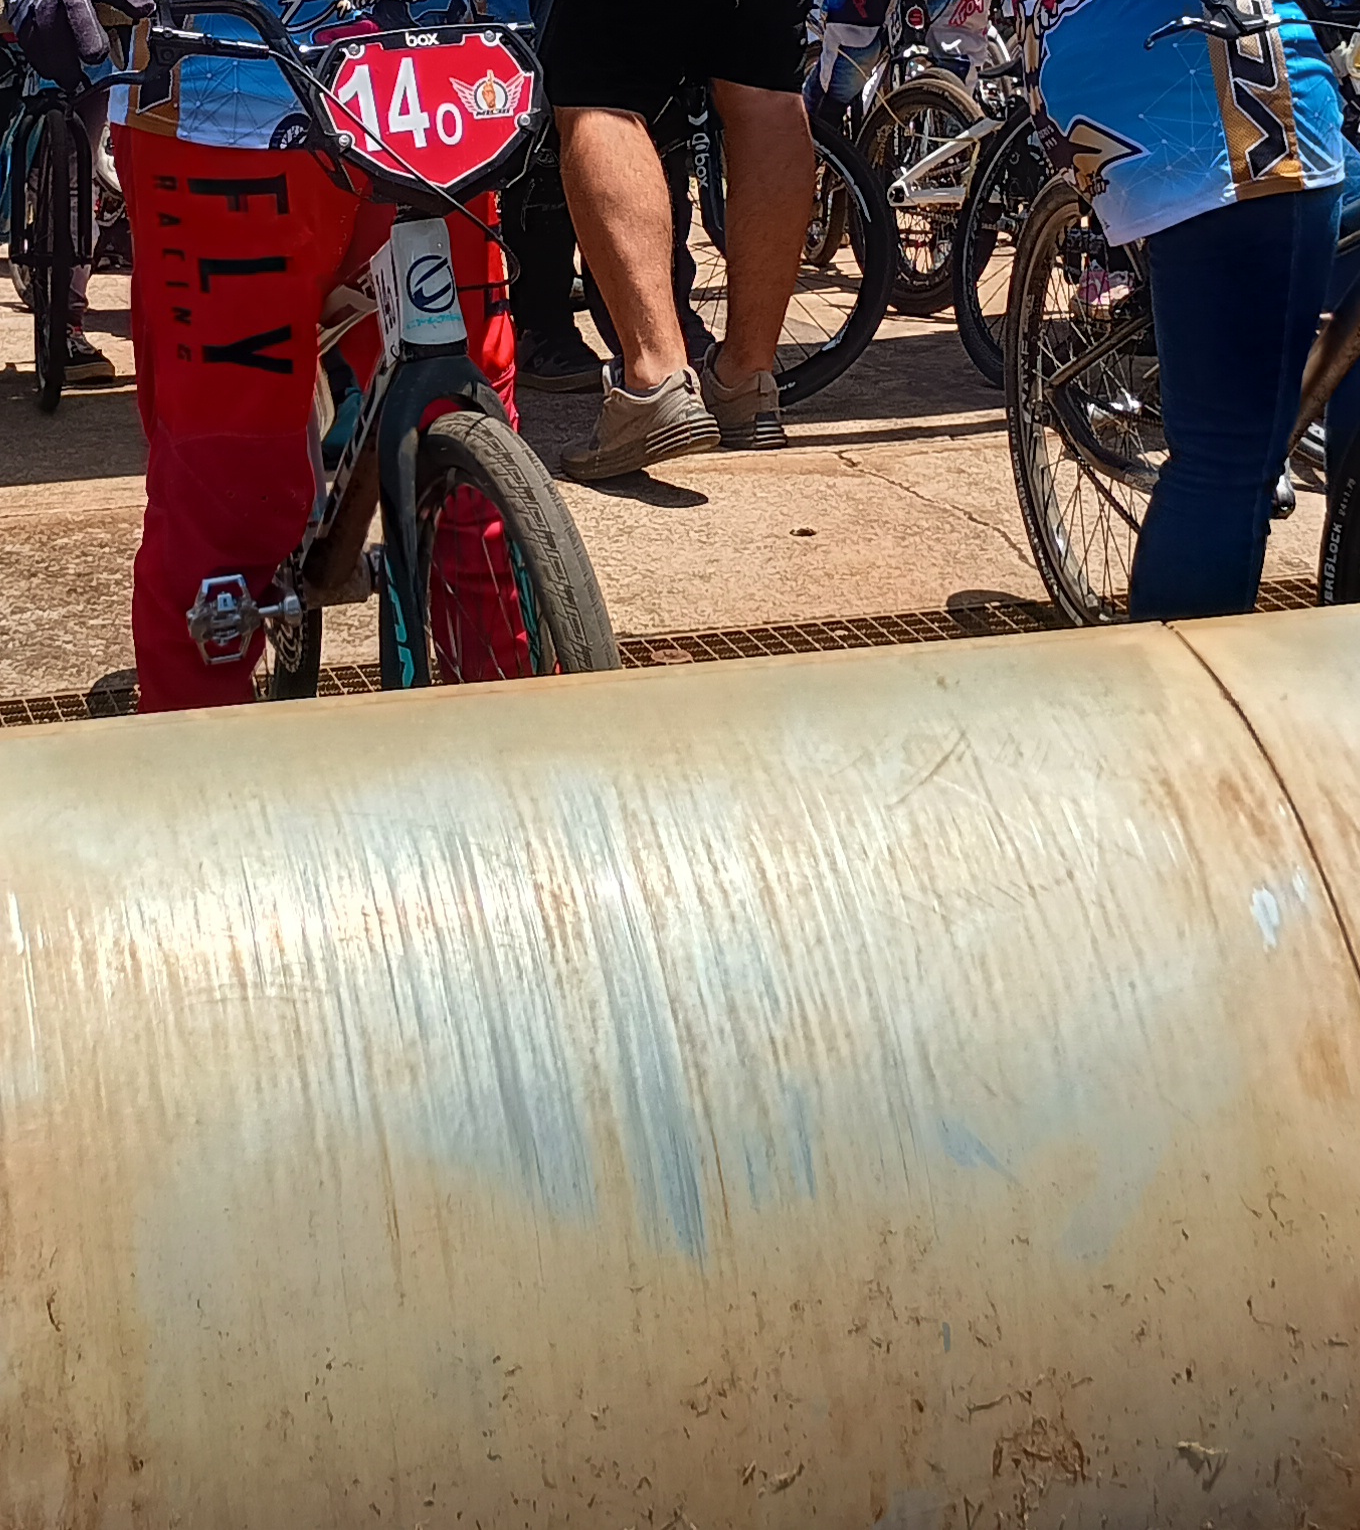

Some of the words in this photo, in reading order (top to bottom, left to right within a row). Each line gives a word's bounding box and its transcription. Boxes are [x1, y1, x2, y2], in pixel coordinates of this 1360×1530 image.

[404, 31, 440, 47] box
[696, 151, 710, 189] box
[151, 174, 194, 363] RACING
[186, 171, 294, 375] FLY
